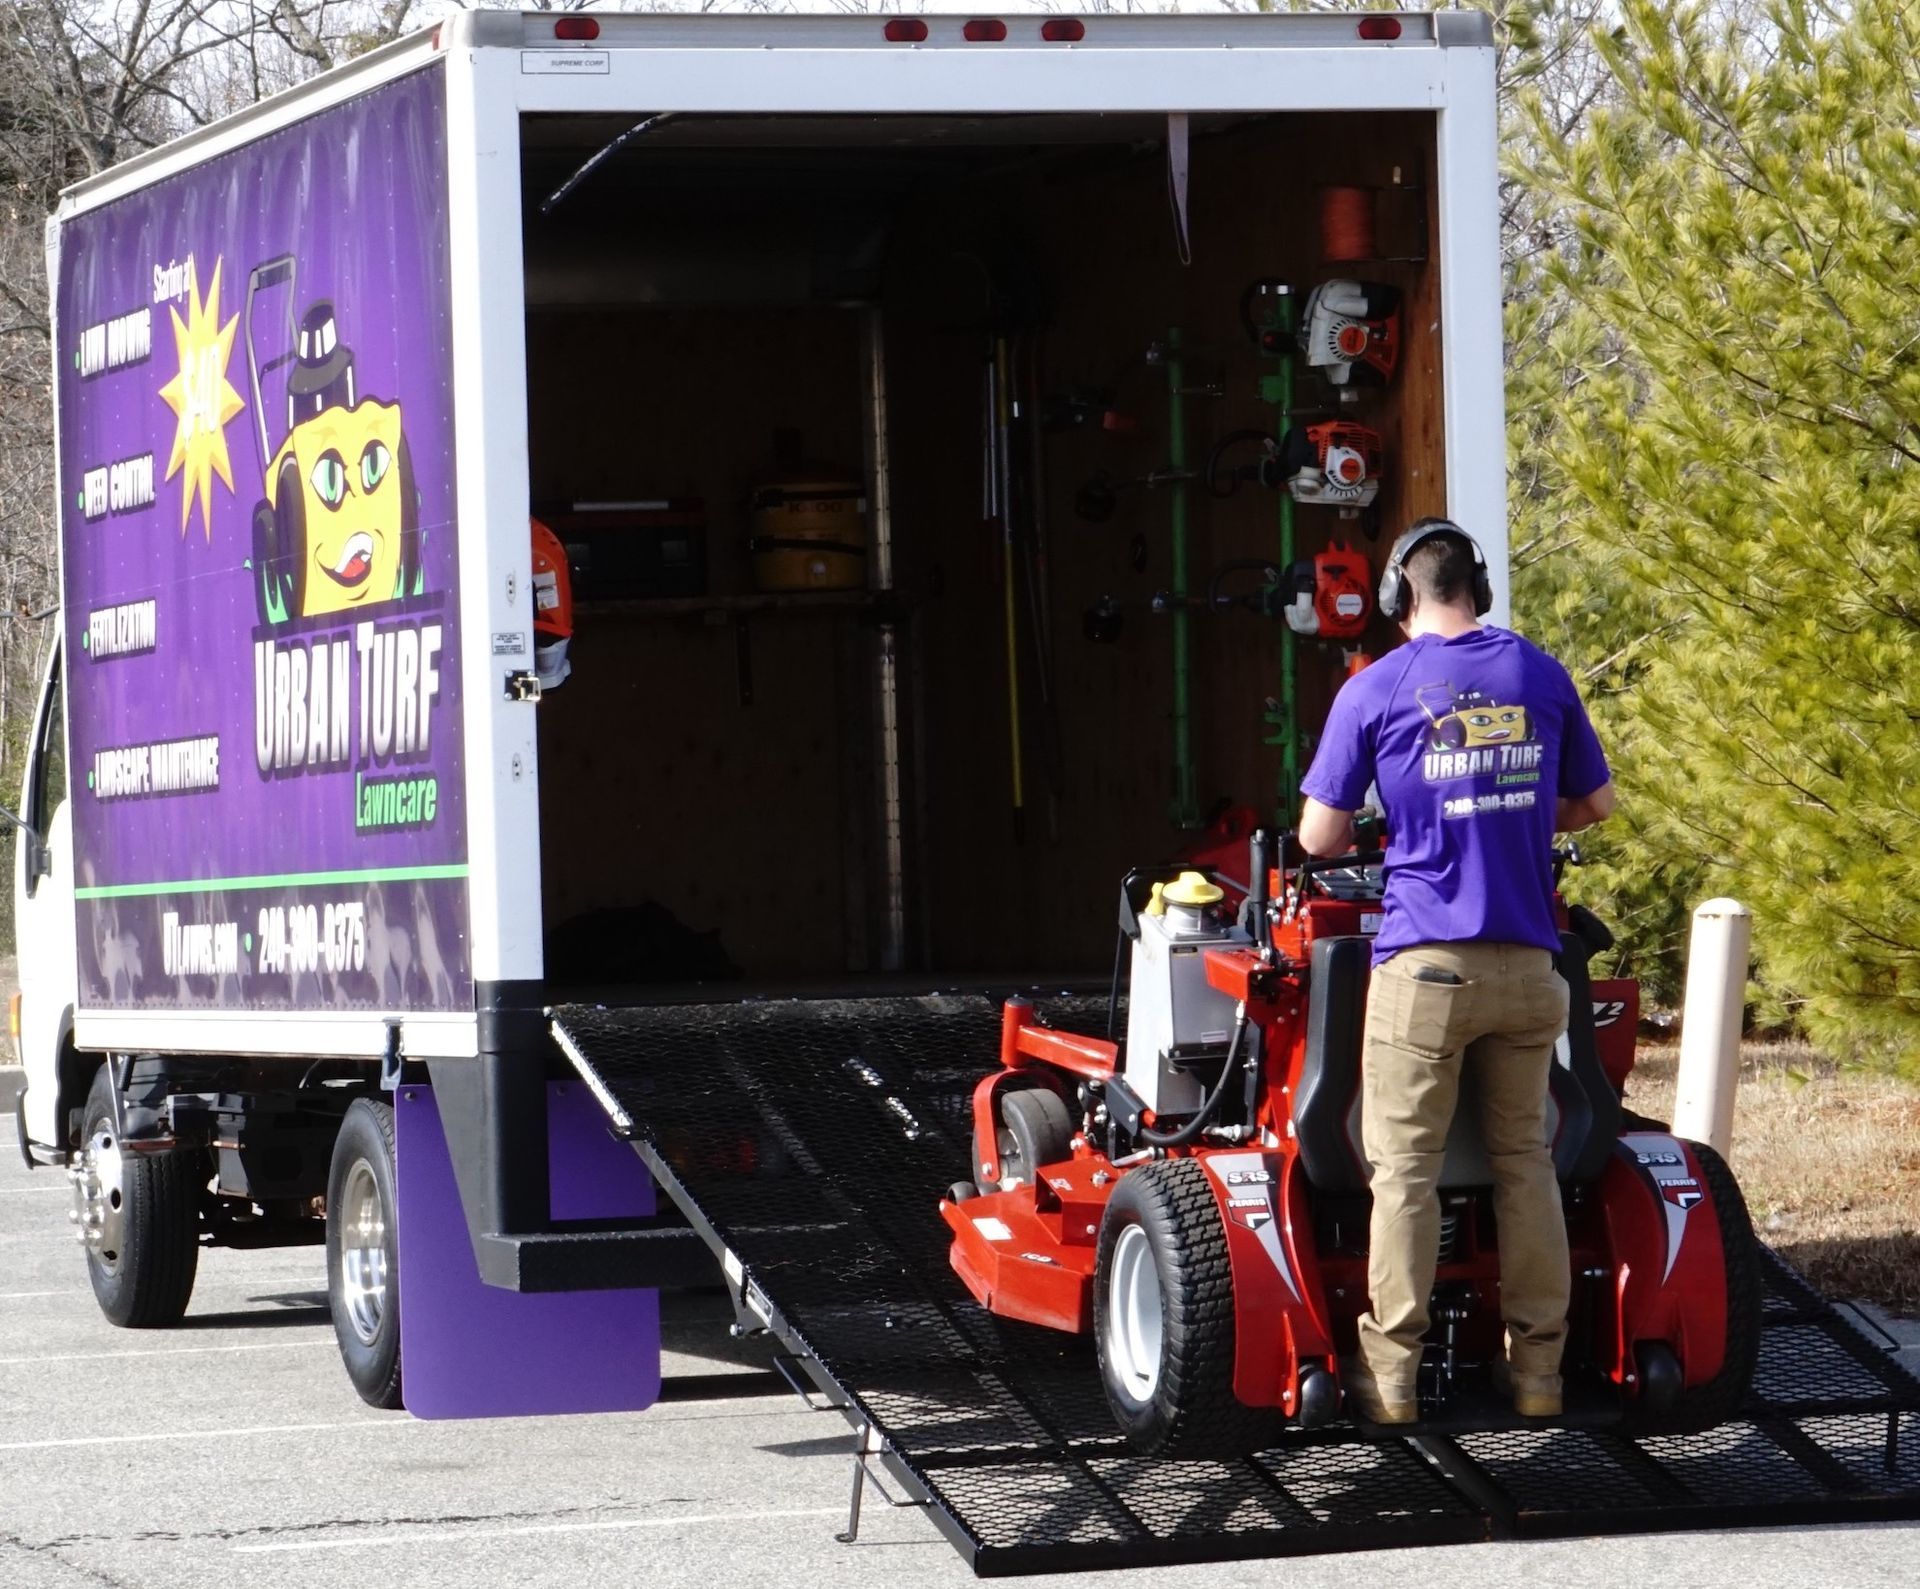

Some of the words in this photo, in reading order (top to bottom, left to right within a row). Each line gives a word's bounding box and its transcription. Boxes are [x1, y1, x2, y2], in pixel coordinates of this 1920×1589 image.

[154, 259, 183, 304] Starting
[81, 324, 106, 377] LAWN
[108, 308, 151, 367] MOWING
[84, 468, 108, 517] WEED
[110, 455, 155, 511] CONTROL
[90, 600, 156, 659] FERTILIZATION
[254, 638, 350, 772] URBAN
[356, 621, 442, 759] TURF
[95, 746, 149, 798] LANDSCAPE
[150, 737, 219, 792] MAINTENANCE
[1423, 751, 1494, 781] URBAN
[1499, 744, 1544, 771] TURF
[1495, 772, 1541, 786] Lawncare
[355, 772, 437, 828] Lawncare
[1443, 791, 1536, 818] 240-300-0375
[258, 902, 365, 974] 240-300-0375
[1228, 1170, 1271, 1184] SRS
[1637, 1152, 1678, 1164] SRS
[1228, 1199, 1267, 1208] FERRIS
[1660, 1179, 1698, 1187] FERRIS
